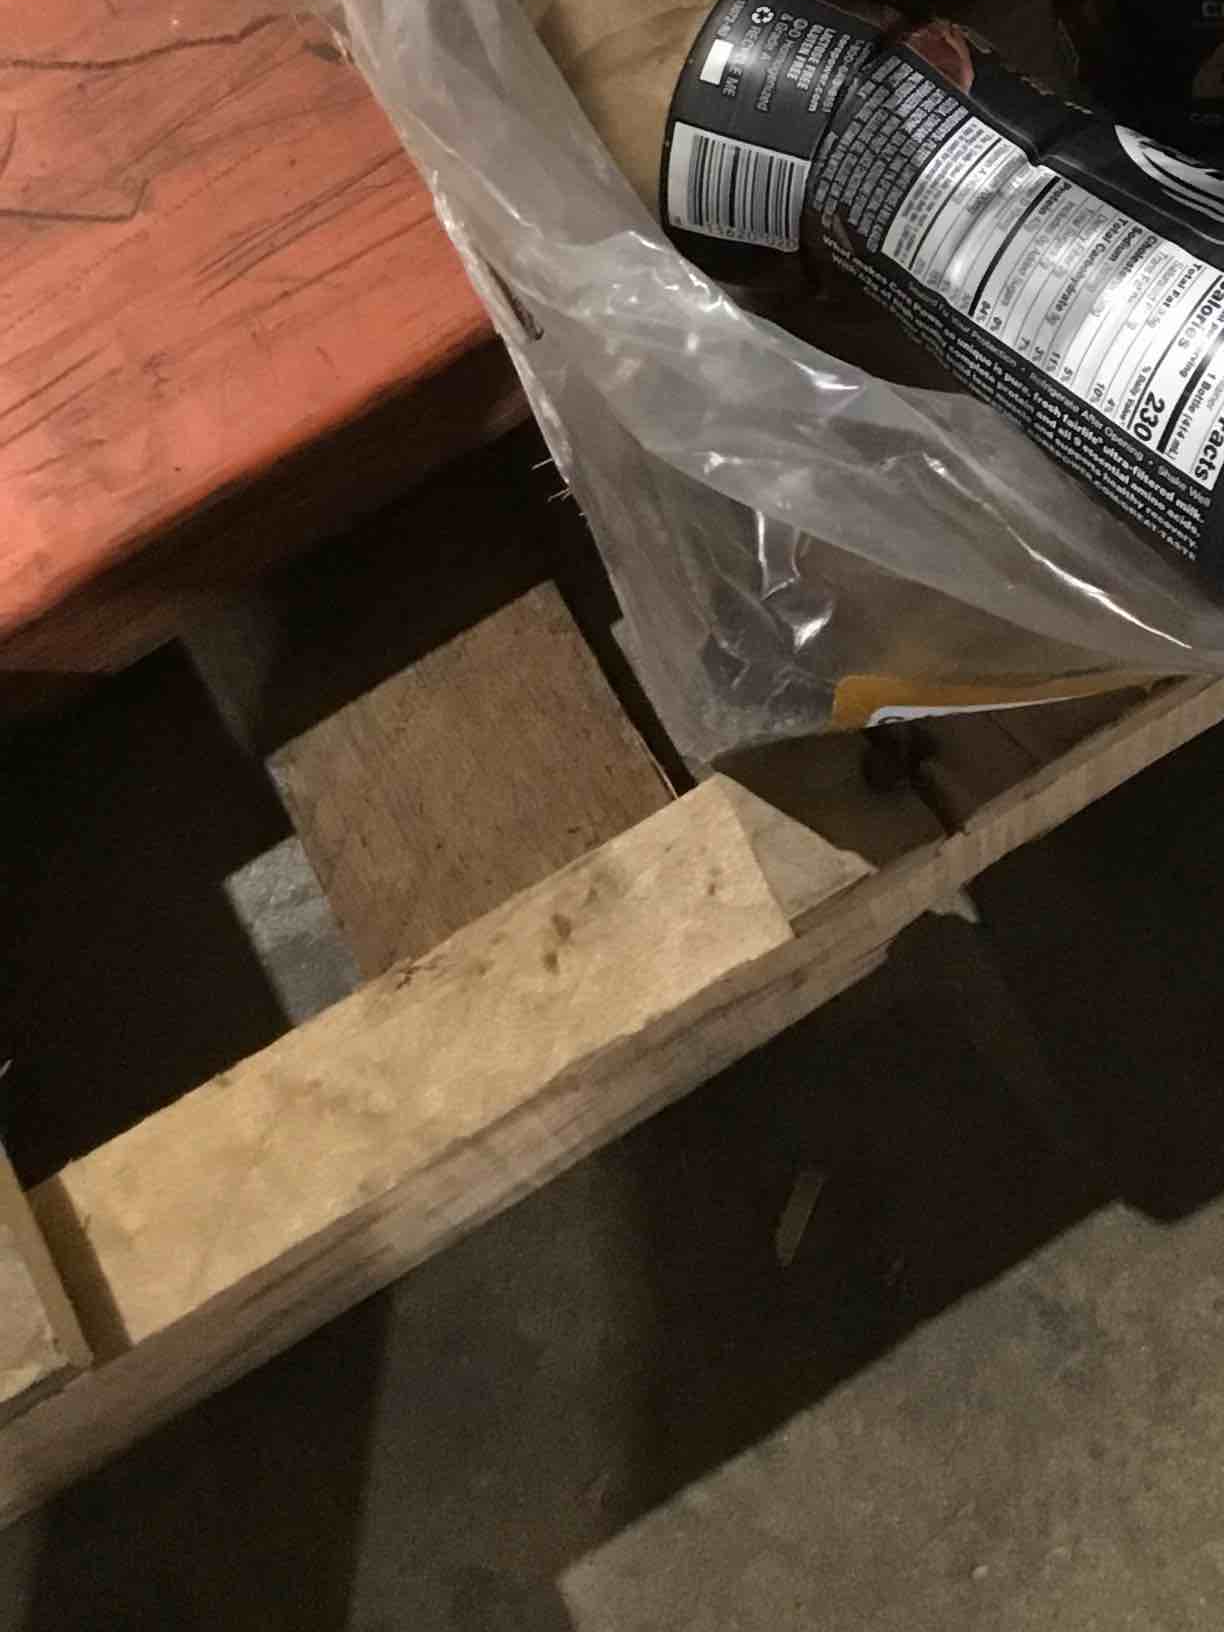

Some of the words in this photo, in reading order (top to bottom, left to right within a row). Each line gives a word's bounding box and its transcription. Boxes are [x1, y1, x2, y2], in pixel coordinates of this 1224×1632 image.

[797, 23, 823, 55] GLUTEN
[807, 27, 836, 64] LACTOSE
[785, 54, 805, 81] FREE
[796, 63, 816, 91] FREE
[721, 75, 740, 98] ME
[1037, 179, 1071, 217] Protein
[1100, 215, 1128, 244] Total
[1108, 223, 1143, 264] Sodium
[1053, 241, 1108, 313] Carbohydrate
[1176, 261, 1202, 289] Total
[1161, 287, 1181, 308] Fat
[1188, 380, 1213, 415] Bottle
[955, 336, 993, 370] unique
[1030, 391, 1063, 419] fresh
[1100, 443, 1176, 503] ultra-filtered
[1173, 496, 1206, 525] milk.
[1130, 391, 1169, 443] 230
[1079, 409, 1104, 430] After
[1101, 425, 1145, 463] Opening
[1186, 485, 1212, 508] Well
[1079, 443, 1132, 485] essential
[1129, 480, 1167, 512] amino
[1164, 506, 1202, 539] acids,
